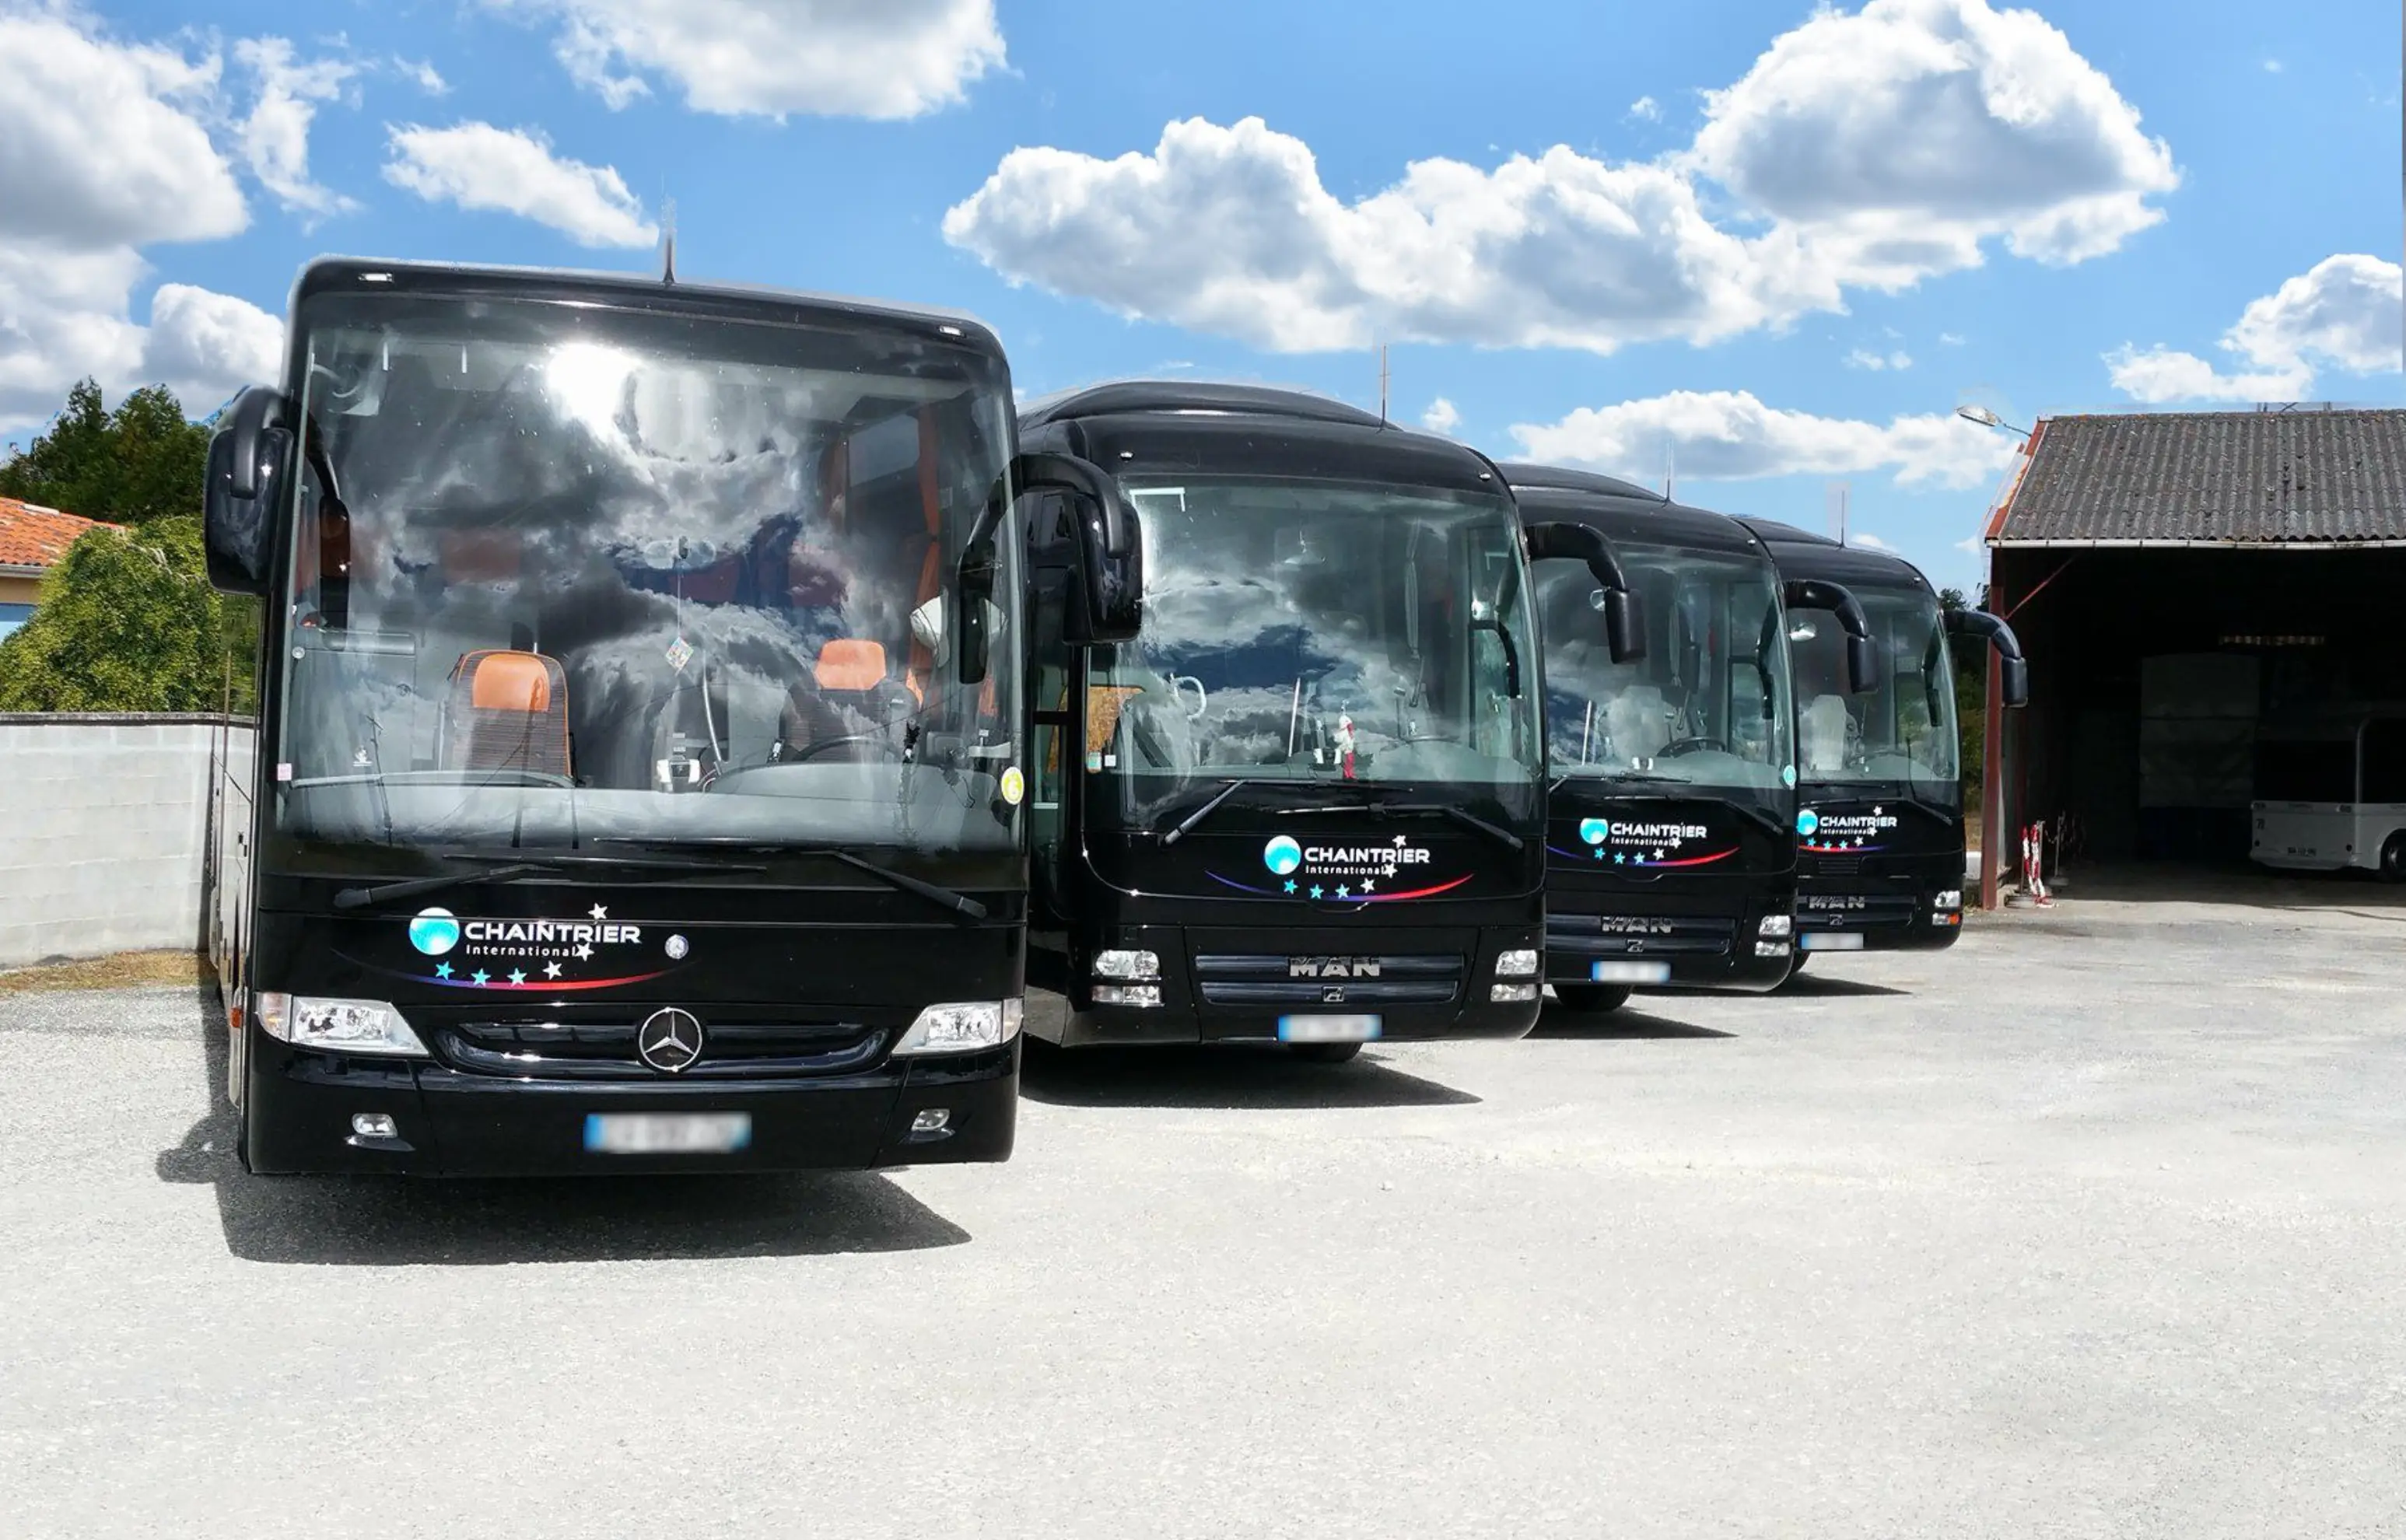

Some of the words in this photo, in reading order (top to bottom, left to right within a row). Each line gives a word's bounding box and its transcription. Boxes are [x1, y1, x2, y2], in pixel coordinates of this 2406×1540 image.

[1819, 816, 1897, 827] CHAINTRIER
[1610, 823, 1707, 838] CHAINTRIER
[1304, 846, 1431, 863] CHAINTRIER
[1305, 865, 1387, 875] International
[1809, 896, 1865, 909] MAN
[1601, 916, 1672, 933] MAN
[464, 922, 641, 943] CHAINTRIER
[466, 945, 576, 957] International
[1288, 957, 1382, 977] MAN
